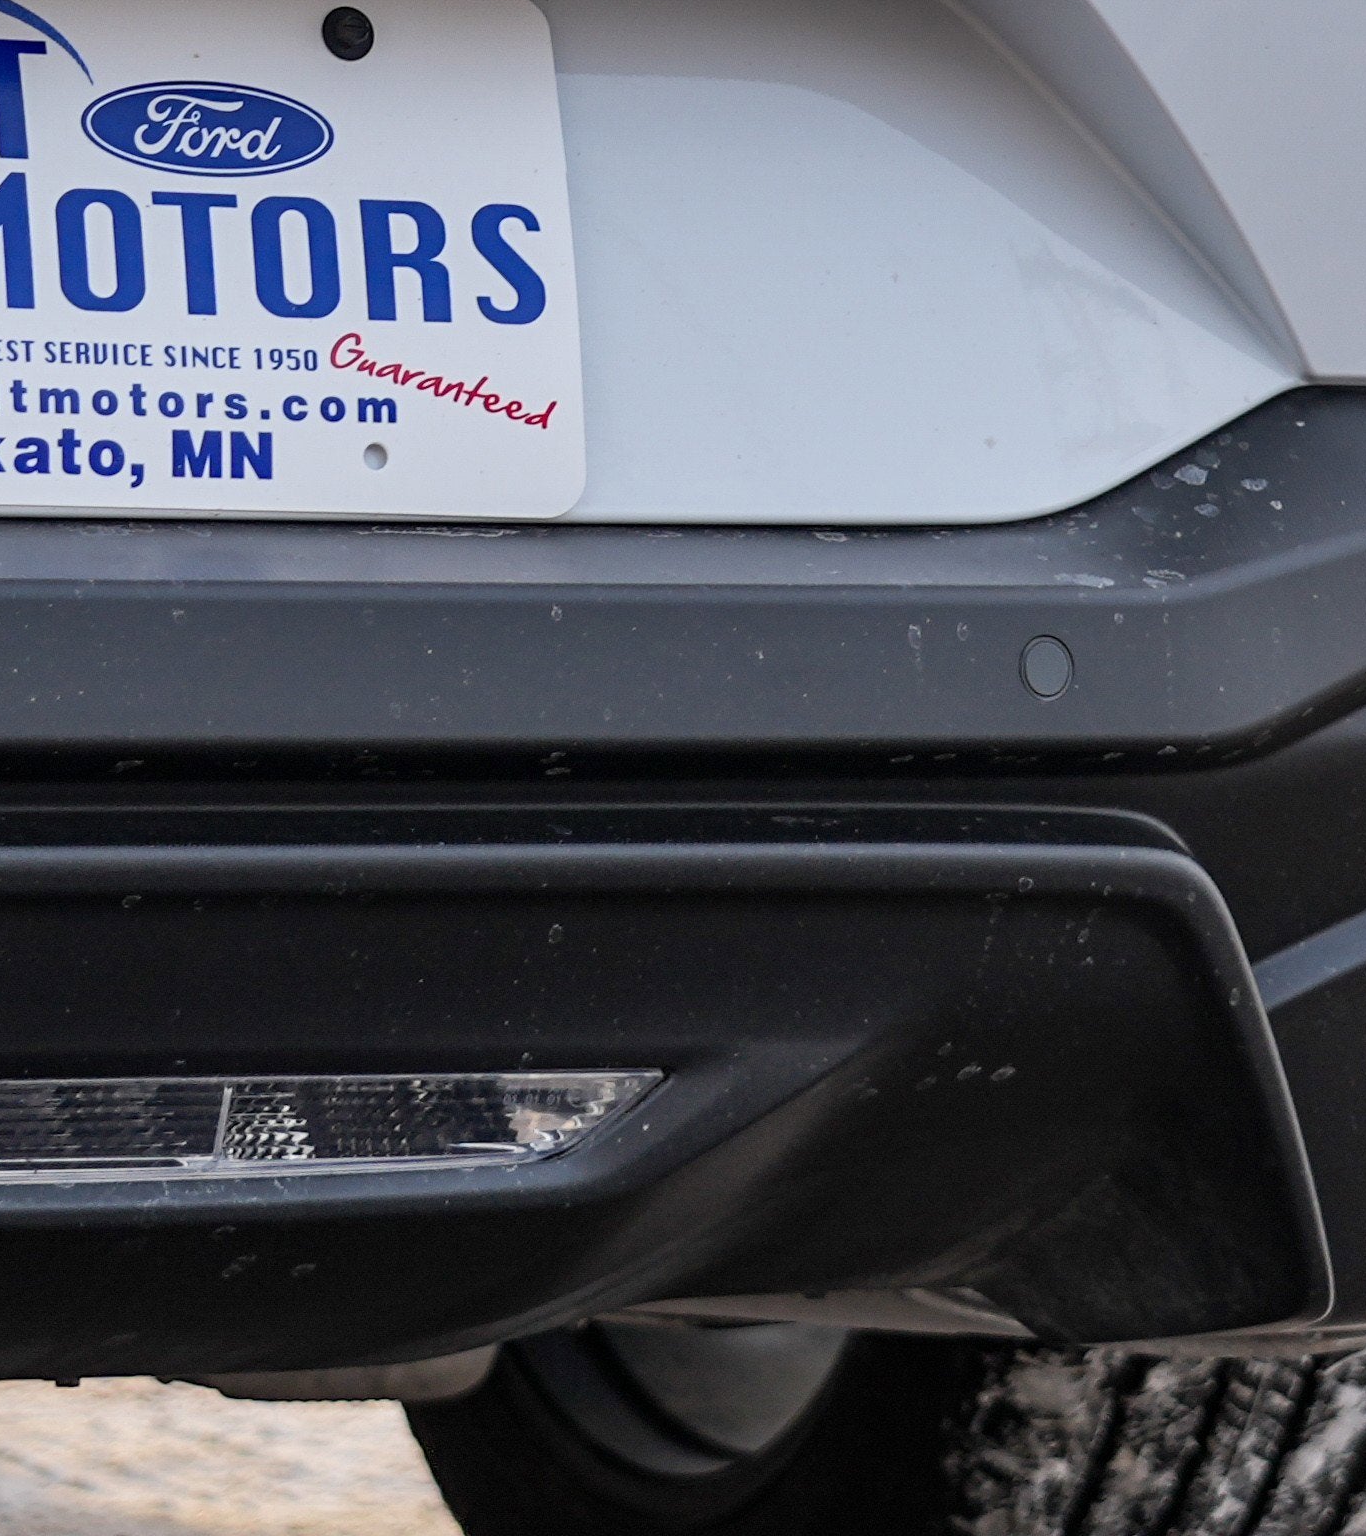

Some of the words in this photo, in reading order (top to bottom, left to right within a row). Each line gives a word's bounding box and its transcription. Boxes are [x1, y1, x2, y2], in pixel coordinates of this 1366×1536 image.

[134, 94, 282, 161] Ford
[44, 341, 153, 366] SERVICE
[164, 345, 241, 369] SINCE
[253, 348, 318, 371] 1950
[330, 333, 557, 429] Guaranteed
[171, 429, 274, 480] MN
